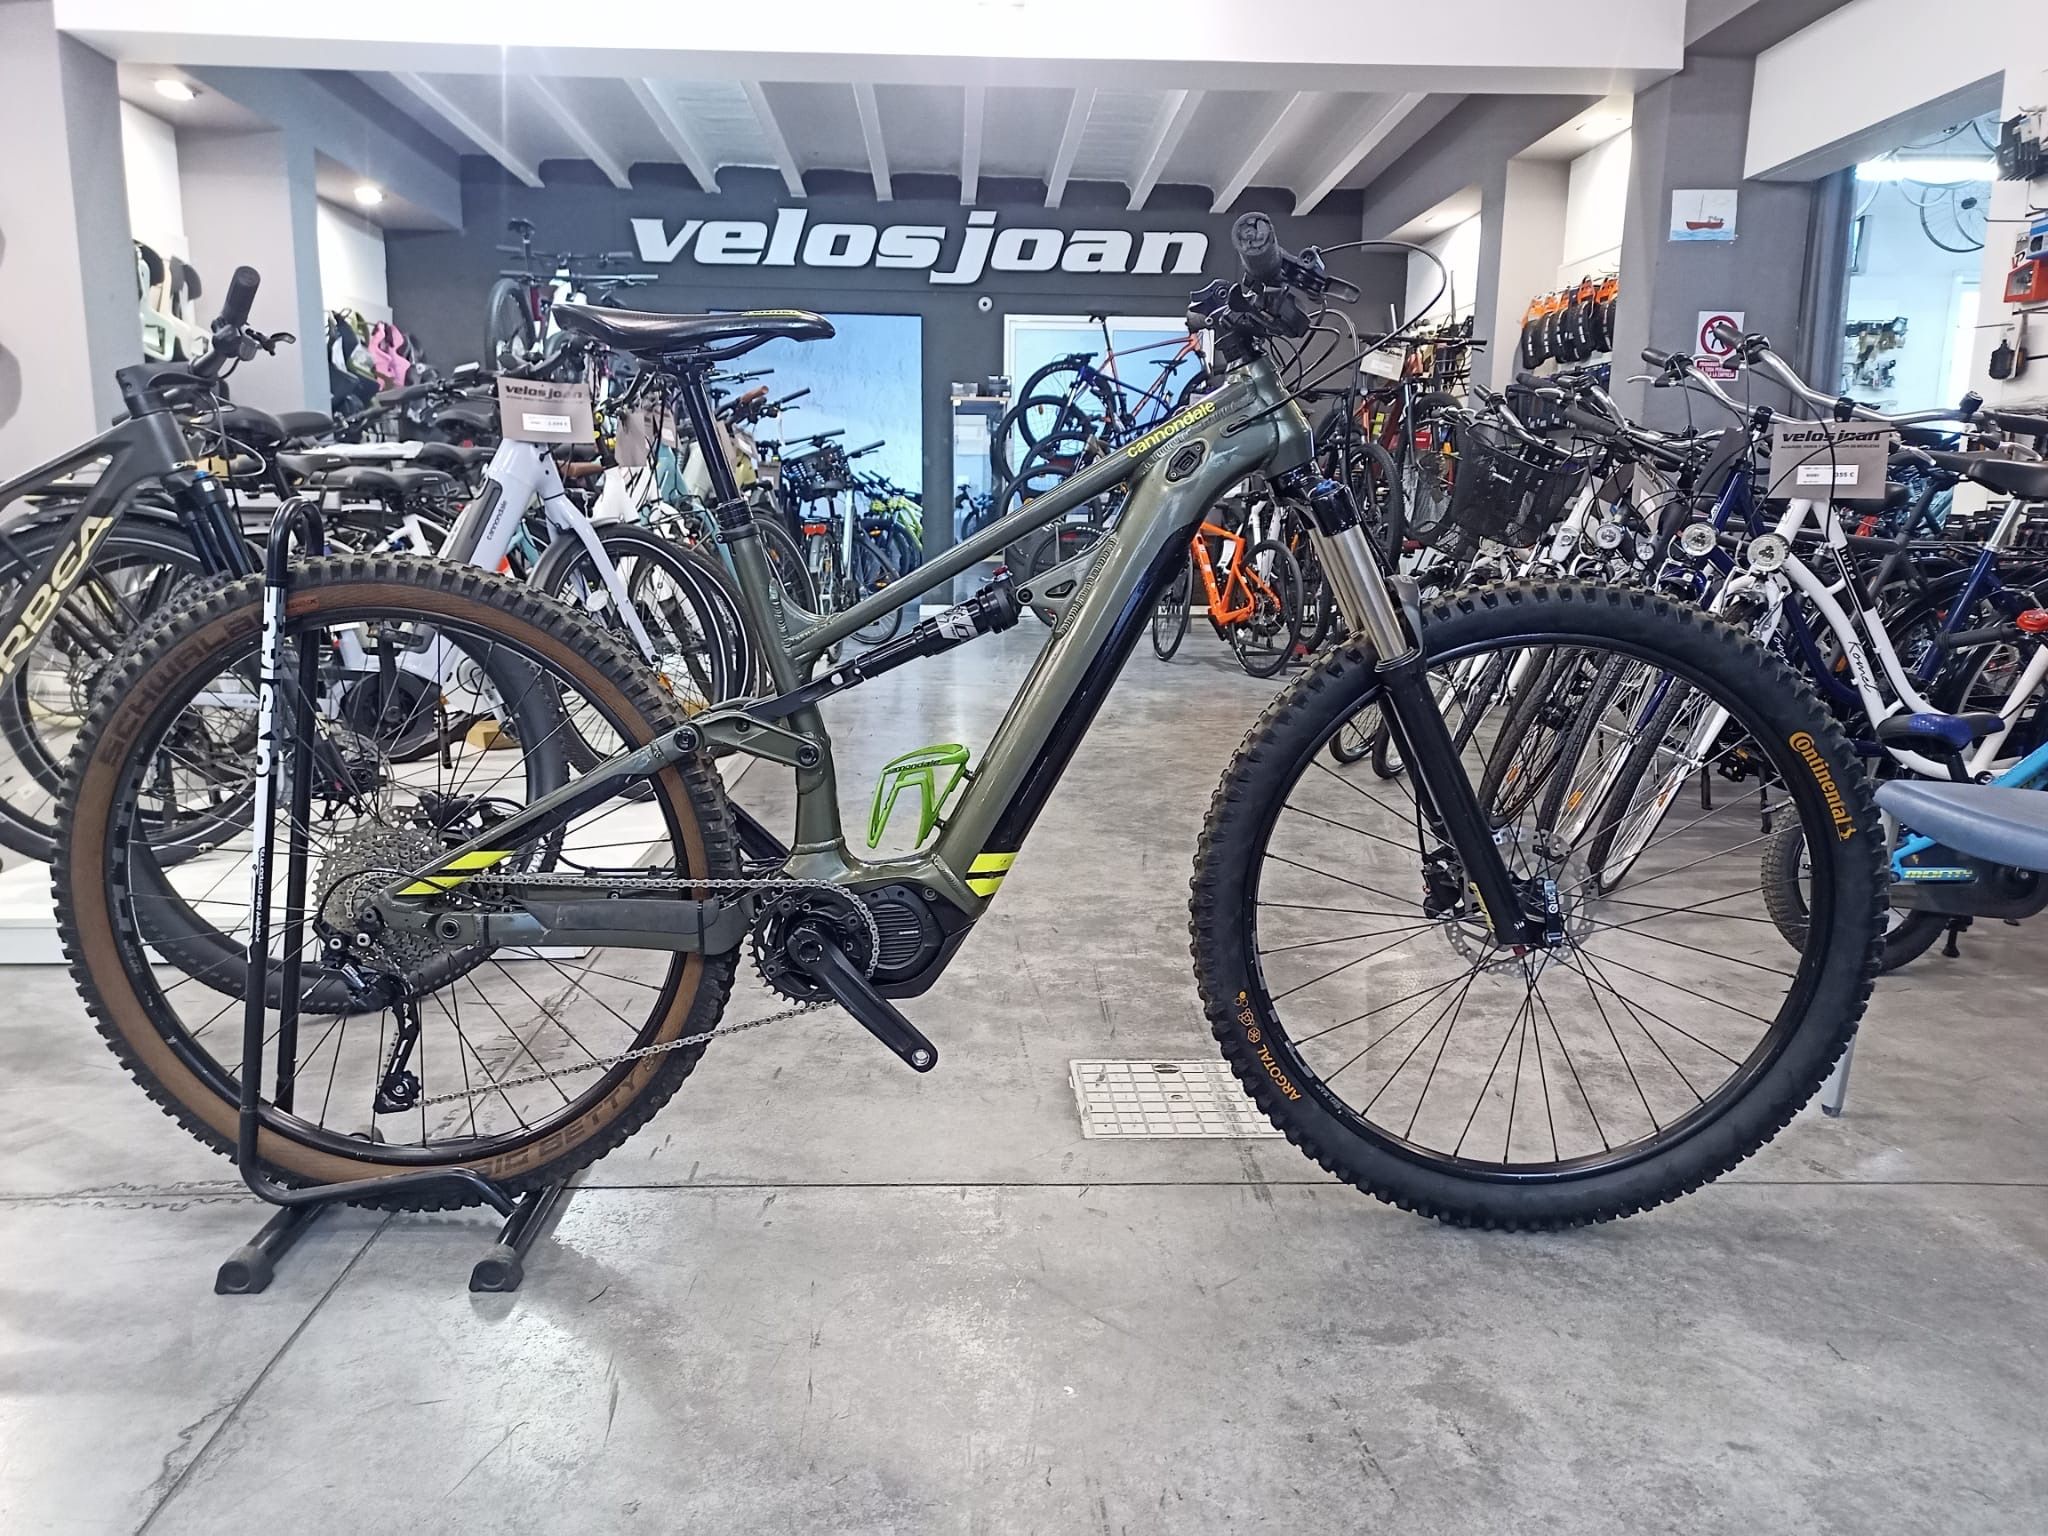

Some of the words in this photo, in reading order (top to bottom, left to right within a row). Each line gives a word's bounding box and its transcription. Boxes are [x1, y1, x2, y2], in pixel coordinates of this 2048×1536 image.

[1127, 400, 1217, 458] cannondale
[0, 516, 113, 688] RBEA
[101, 610, 261, 768] SCHWALB
[1789, 731, 1853, 825] Continental
[1257, 1044, 1302, 1101] ARGOTAL
